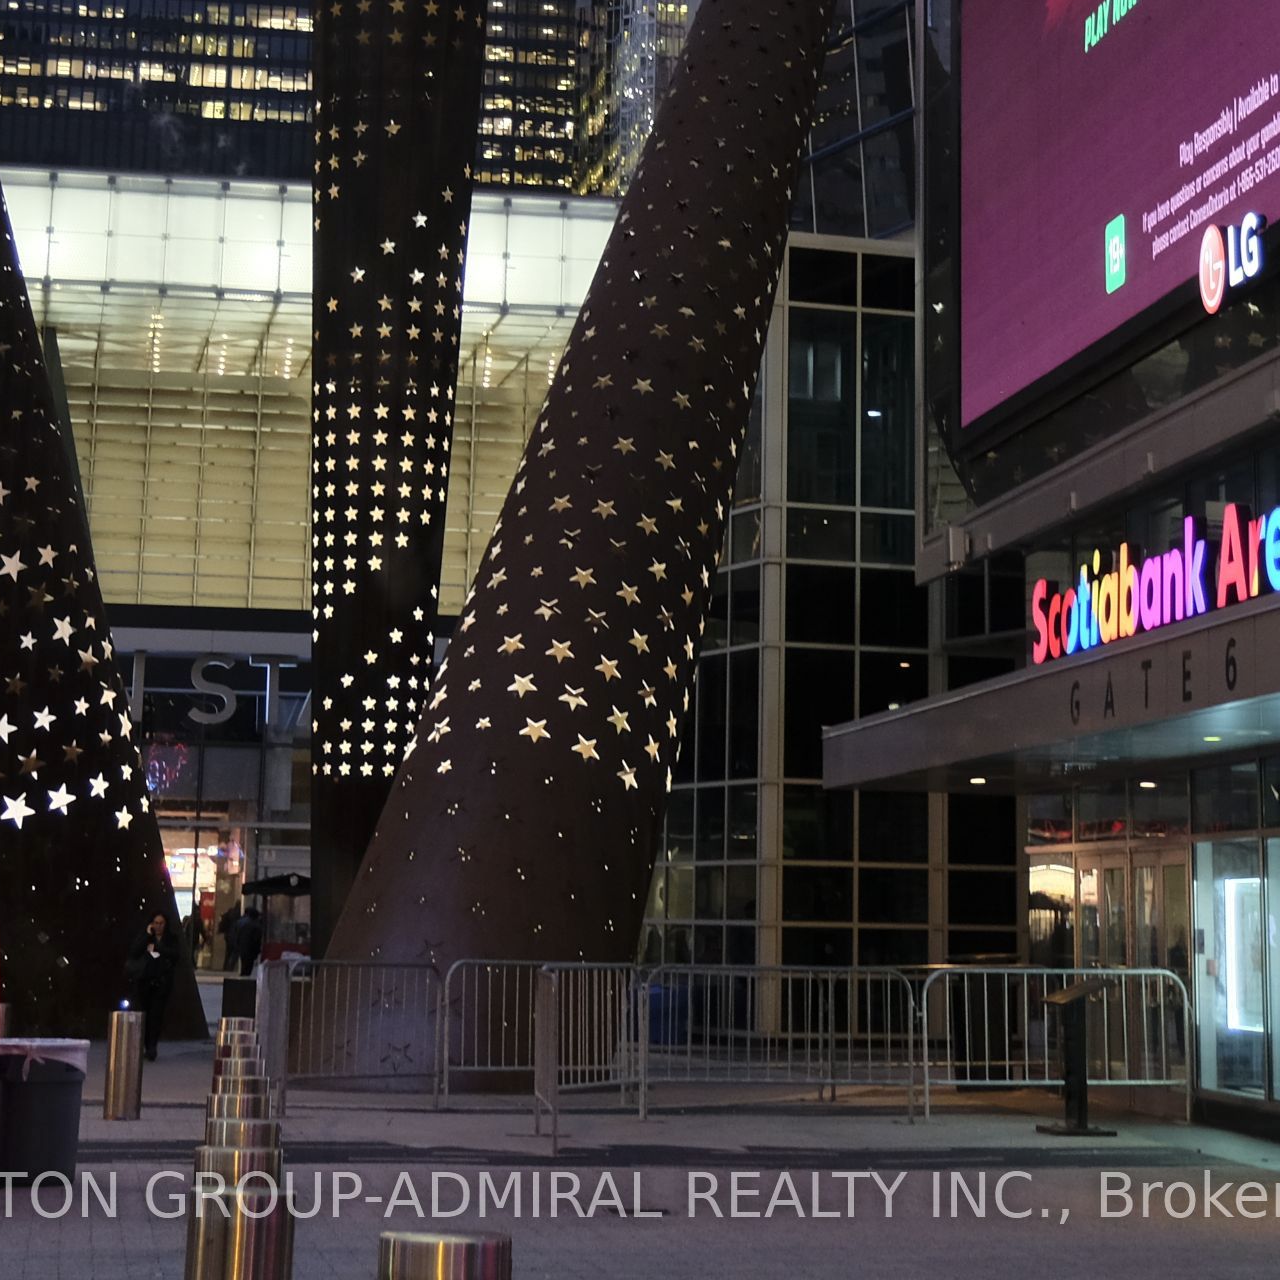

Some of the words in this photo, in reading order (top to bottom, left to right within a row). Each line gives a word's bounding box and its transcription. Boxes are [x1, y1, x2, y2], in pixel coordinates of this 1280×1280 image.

[1179, 141, 1194, 168] Play
[1194, 106, 1234, 156] Responsibly
[1238, 78, 1269, 122] Available
[1270, 73, 1279, 96] to
[1147, 208, 1157, 234] you
[1170, 179, 1196, 215] questions
[1196, 176, 1203, 194] or
[1203, 157, 1229, 190] concerns
[1229, 140, 1246, 170] about
[1246, 131, 1260, 160] your
[1152, 225, 1170, 259] please
[1170, 214, 1189, 242] contact
[1229, 180, 1237, 202] at
[1228, 211, 1262, 287] LG
[1032, 516, 1207, 664] Scotiabank
[1070, 649, 1193, 725] GATE
[1224, 637, 1238, 691] 6
